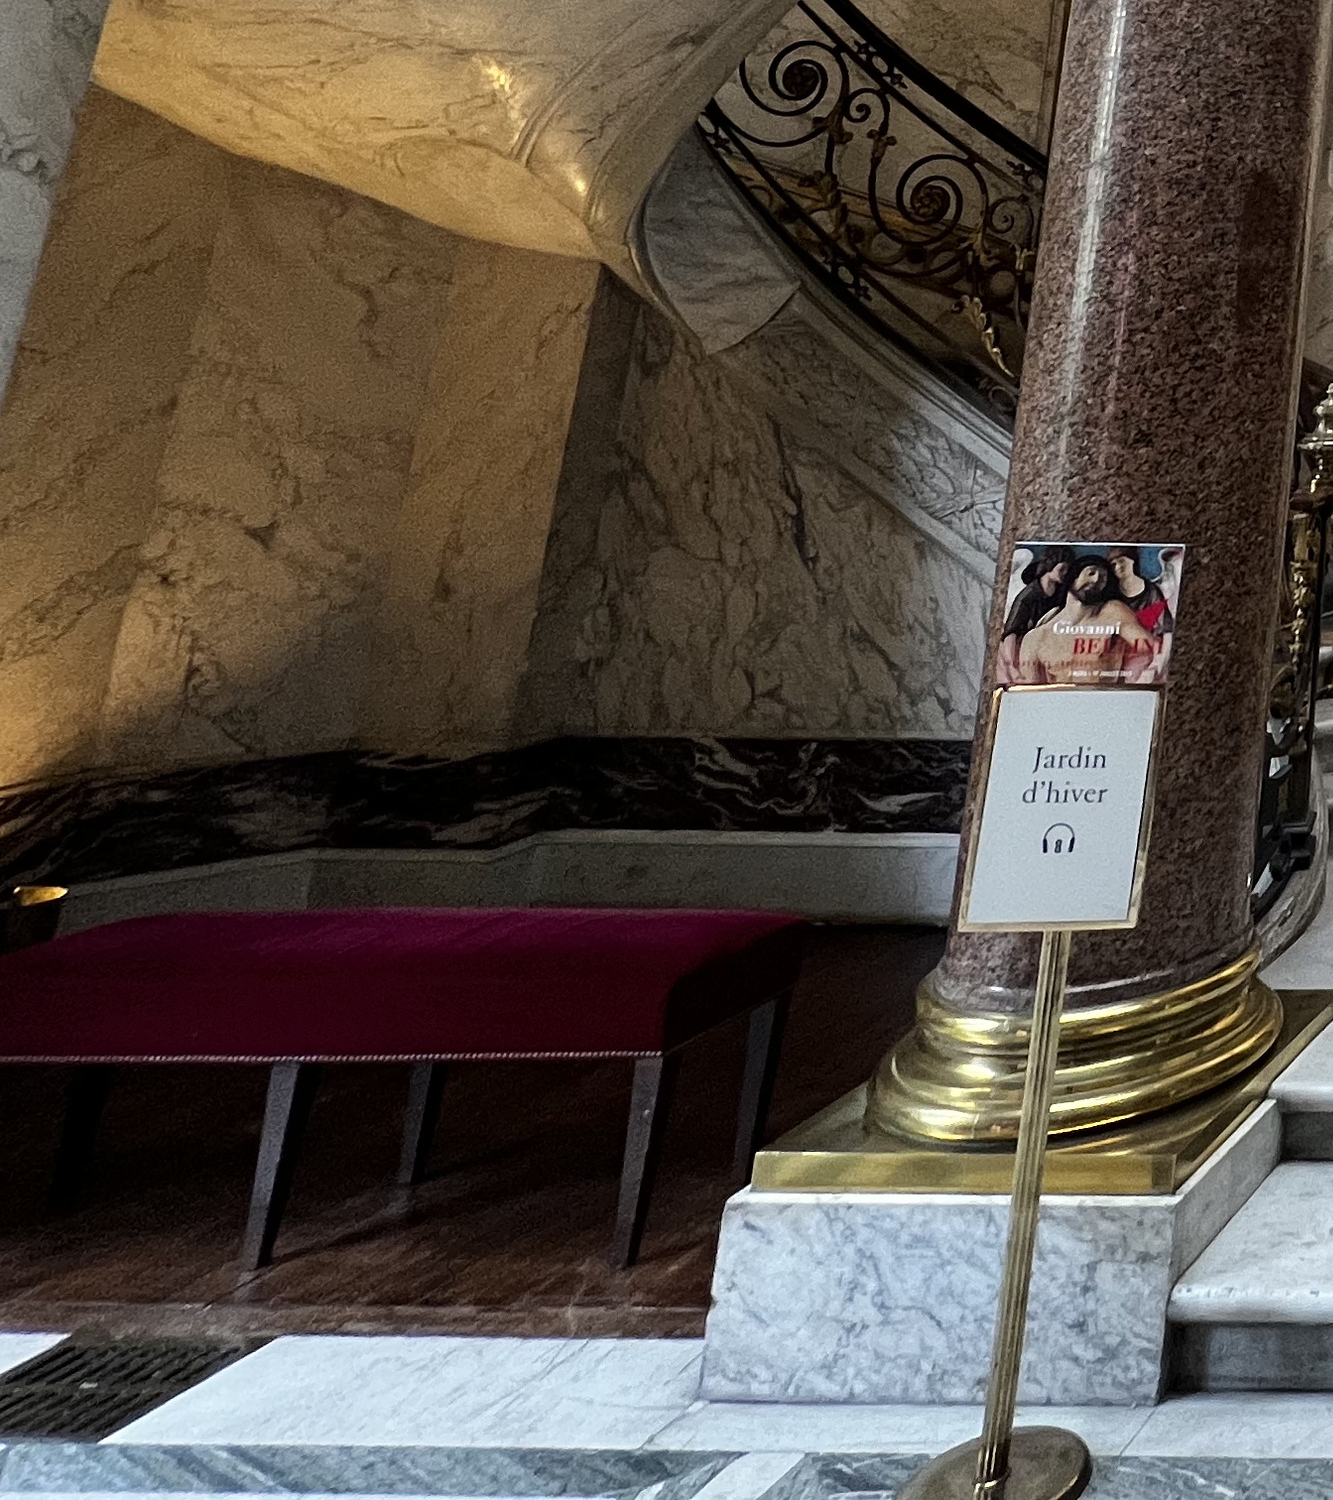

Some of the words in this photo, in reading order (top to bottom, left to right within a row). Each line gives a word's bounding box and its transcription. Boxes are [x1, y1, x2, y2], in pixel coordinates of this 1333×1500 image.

[1052, 621, 1121, 635] Giovanni
[1073, 637, 1165, 655] BELINI
[1032, 746, 1106, 774] Jardin
[1022, 781, 1108, 804] d'hiver
